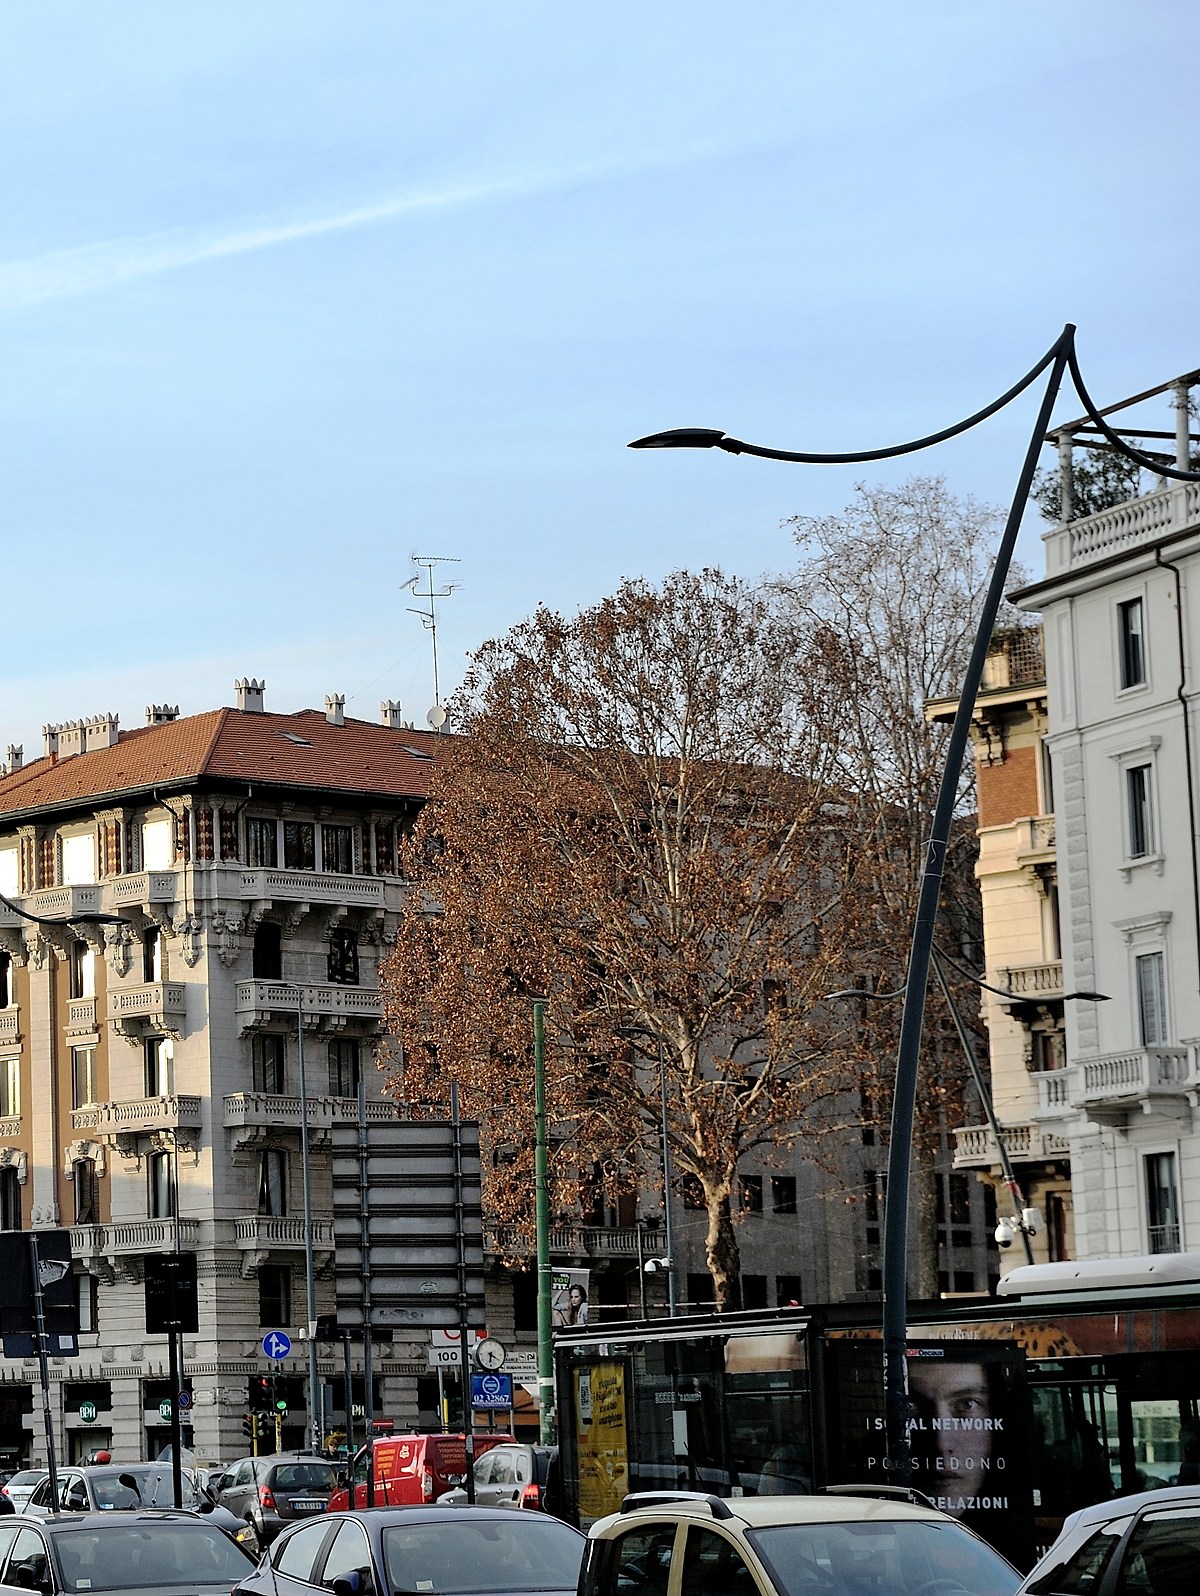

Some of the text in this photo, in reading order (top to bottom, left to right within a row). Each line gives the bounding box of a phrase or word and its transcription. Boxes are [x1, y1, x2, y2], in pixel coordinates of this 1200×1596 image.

[438, 1352, 458, 1362] 100
[473, 1394, 510, 1403] 02 32867
[866, 1418, 870, 1430] I
[932, 1418, 1004, 1431] NETWORK
[867, 1457, 1006, 1470] POSIEDONO
[927, 1496, 1009, 1510] RELAZIONI
